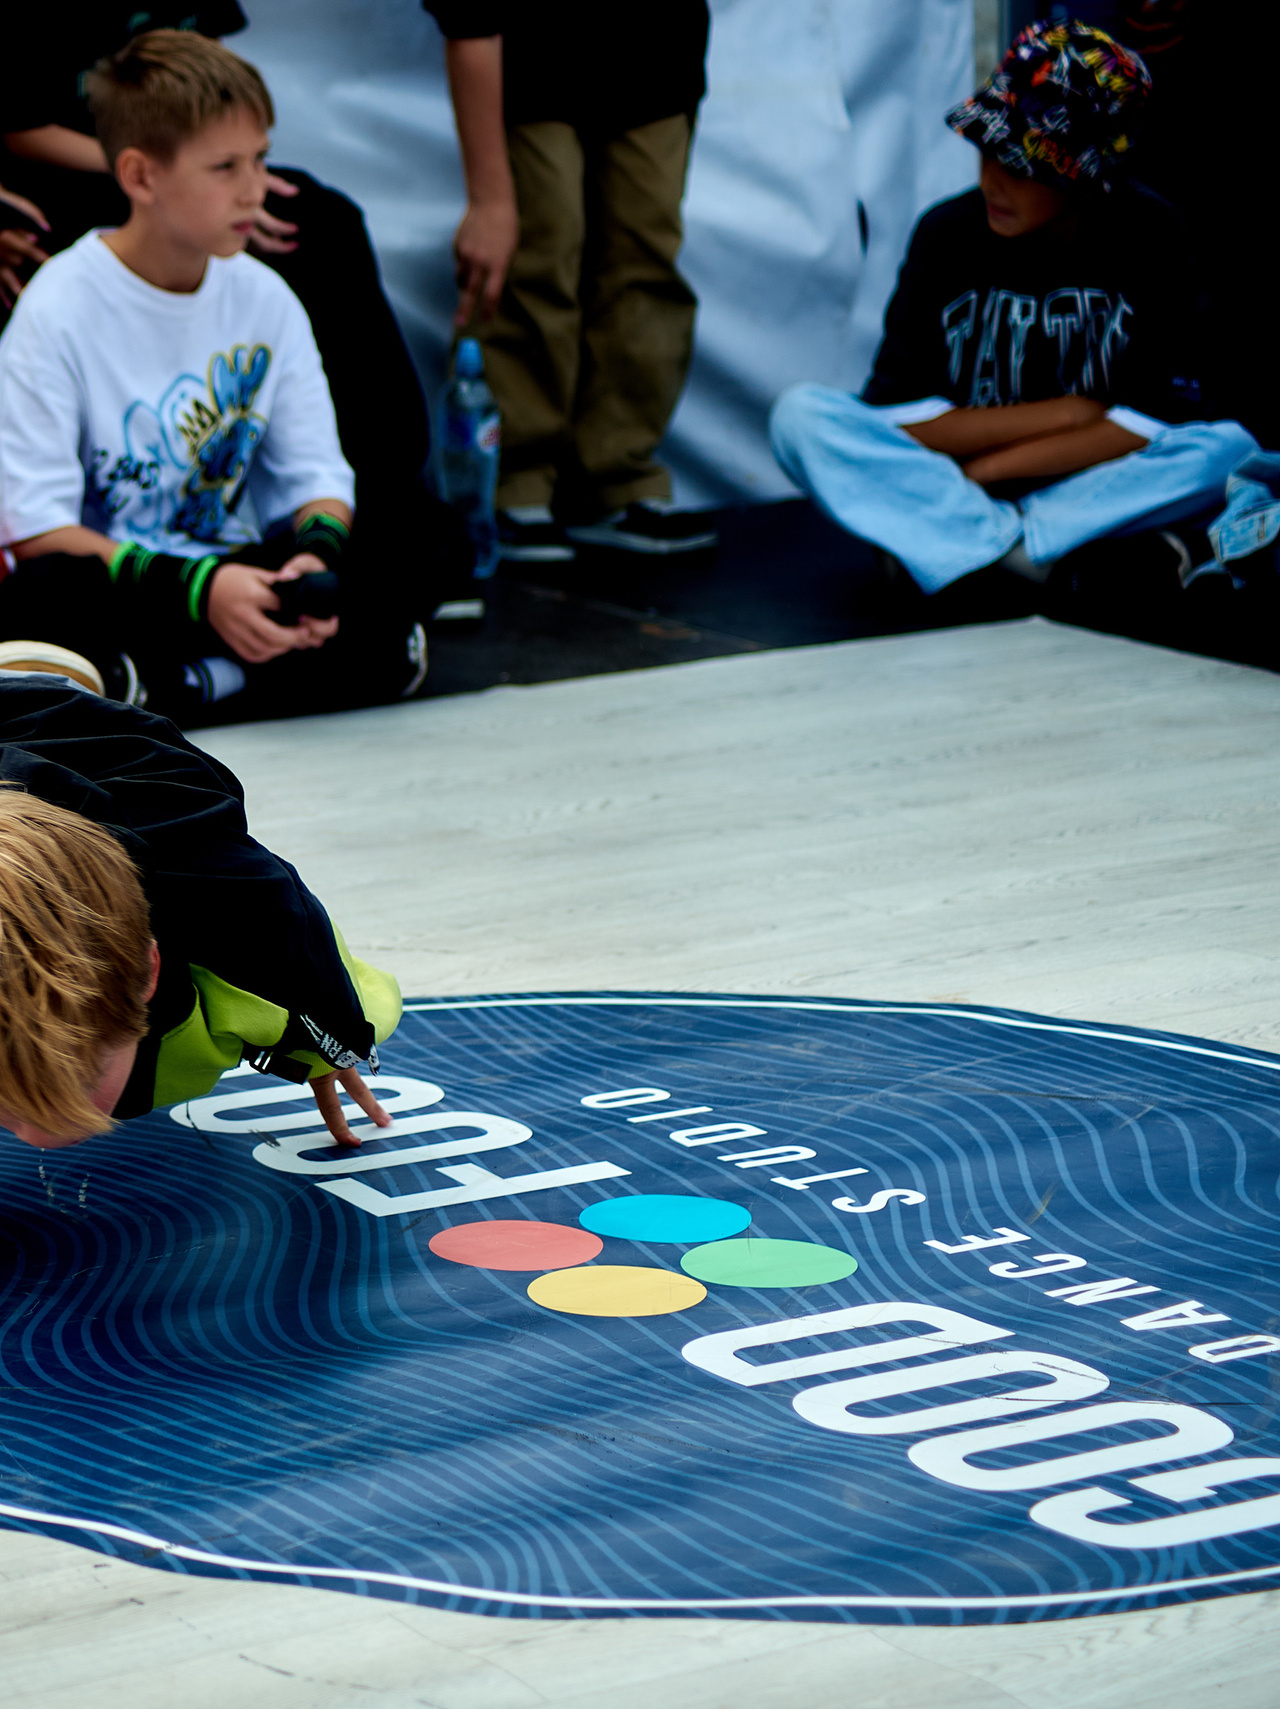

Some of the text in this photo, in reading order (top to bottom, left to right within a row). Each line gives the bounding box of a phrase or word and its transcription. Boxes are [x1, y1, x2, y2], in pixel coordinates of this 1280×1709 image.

[169, 1060, 1280, 1549] GOOD FOO
[580, 1087, 1280, 1364] DANCE STUDIO
